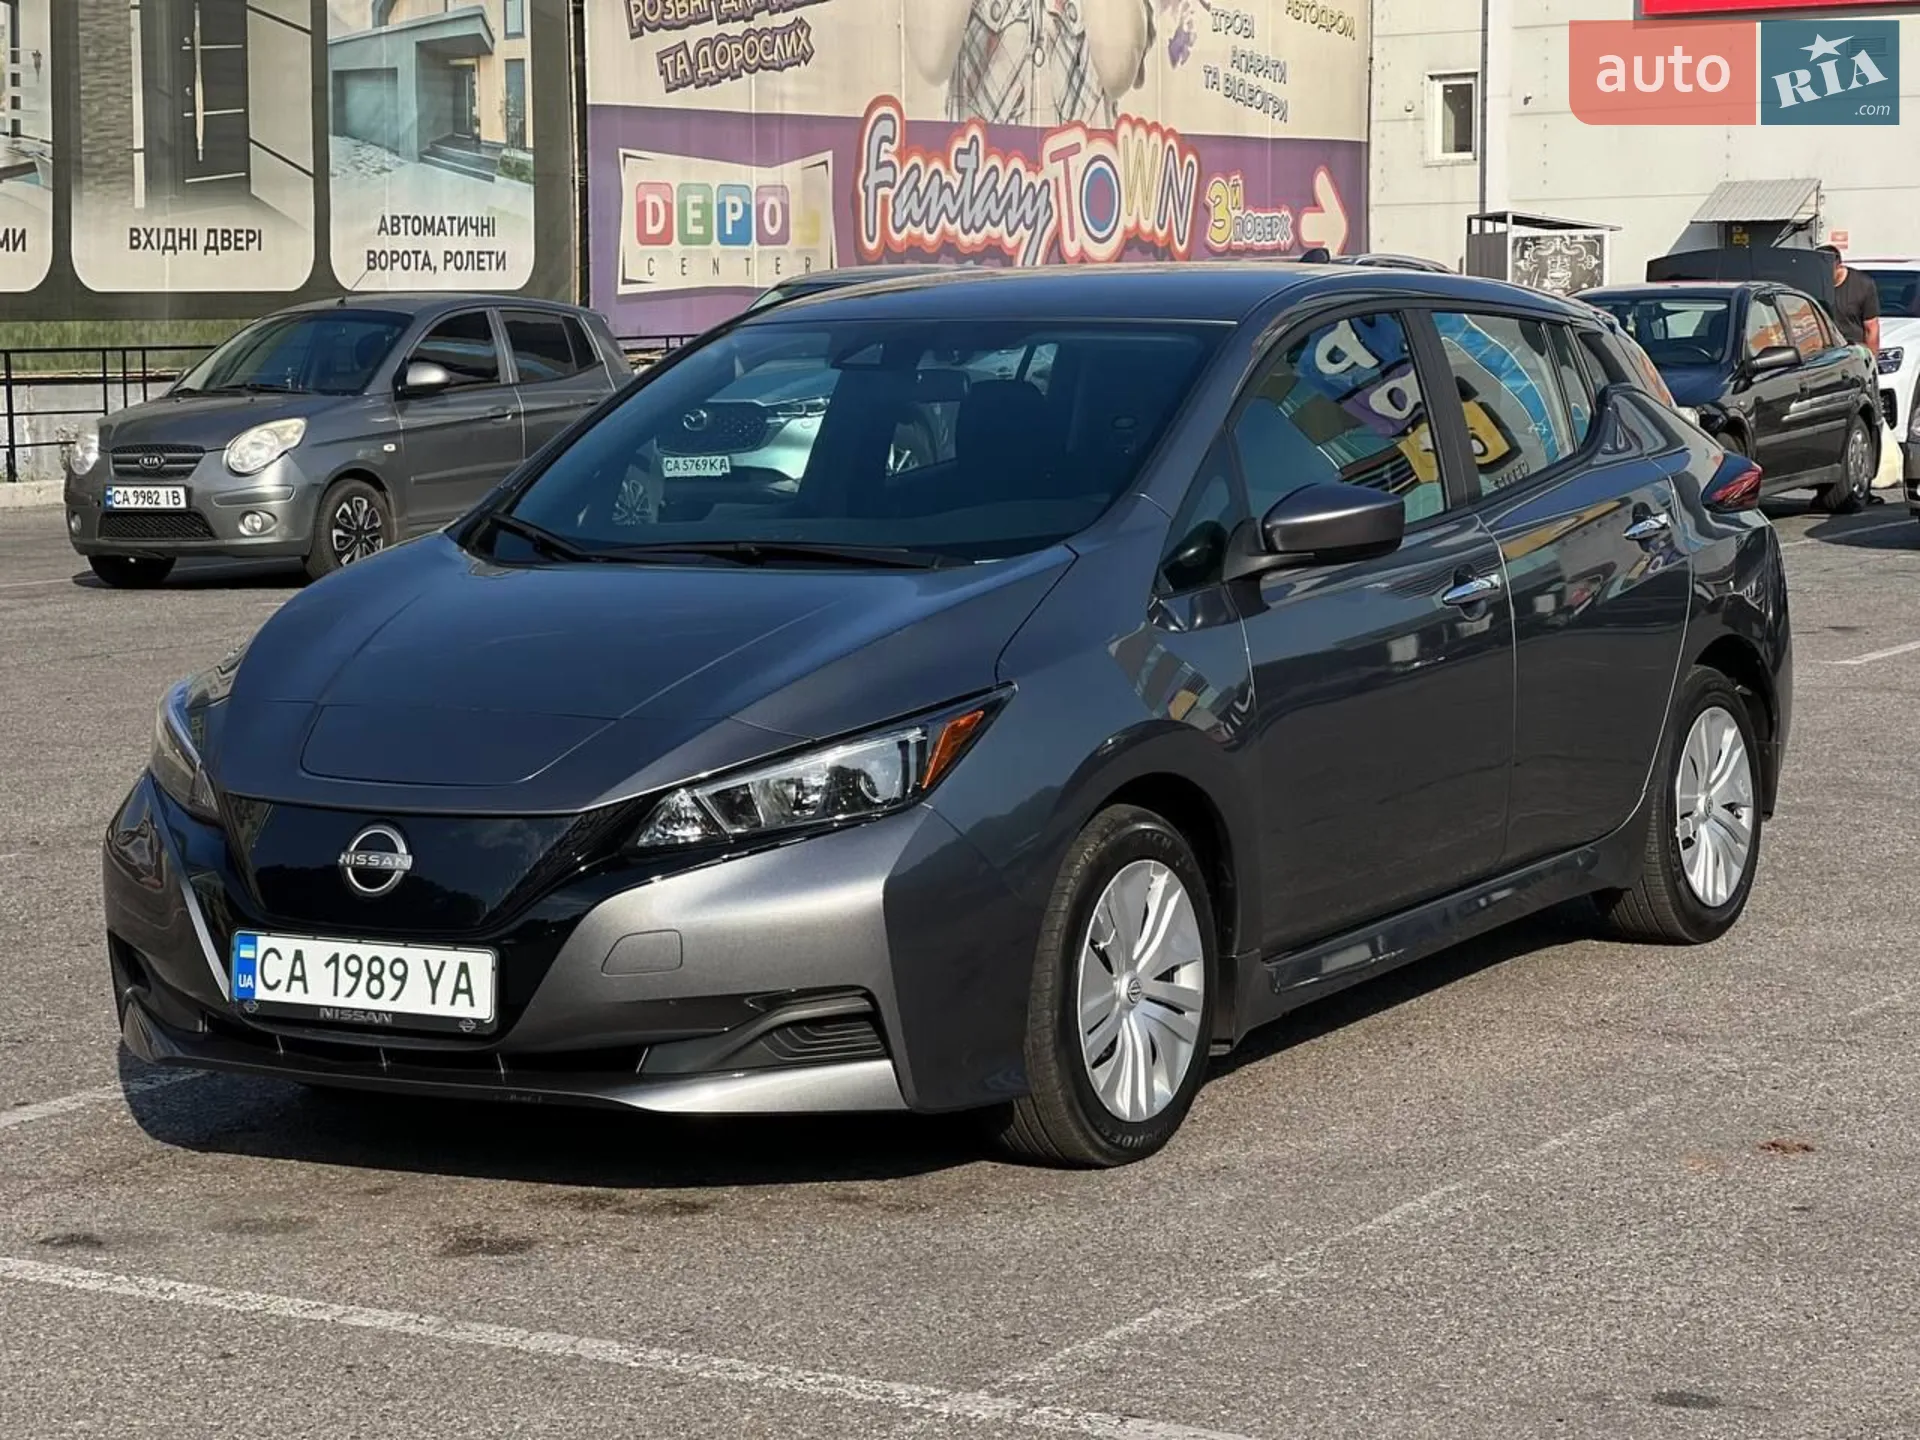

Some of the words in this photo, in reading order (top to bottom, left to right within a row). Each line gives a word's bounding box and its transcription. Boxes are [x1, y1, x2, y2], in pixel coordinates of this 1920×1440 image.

[660, 46, 692, 87] ТА
[696, 23, 814, 82] ДОРОСЛИХ
[1230, 46, 1288, 85] АПАРАТИ
[1202, 65, 1221, 91] ТА
[377, 214, 497, 238] АВТОМАТИЧНІ
[644, 191, 784, 237] DEPO
[1232, 212, 1291, 242] ПОВЕРХ
[129, 227, 198, 256] ВХІДНІ
[203, 228, 263, 256] ДВЕРІ
[366, 250, 438, 274] ВОРОТА,
[443, 251, 507, 272] РОЛЕТИ
[647, 256, 813, 276] CENTER
[143, 457, 160, 466] KIA
[665, 459, 680, 472] CA
[682, 458, 708, 472] 5769
[709, 458, 728, 471] KA
[113, 490, 130, 505] CA
[340, 853, 410, 867] NISSAN
[238, 973, 254, 988] UA
[259, 947, 309, 994] CA
[324, 952, 409, 1001] 1989
[423, 959, 475, 1007] YA
[319, 1007, 392, 1025] NISSAN
